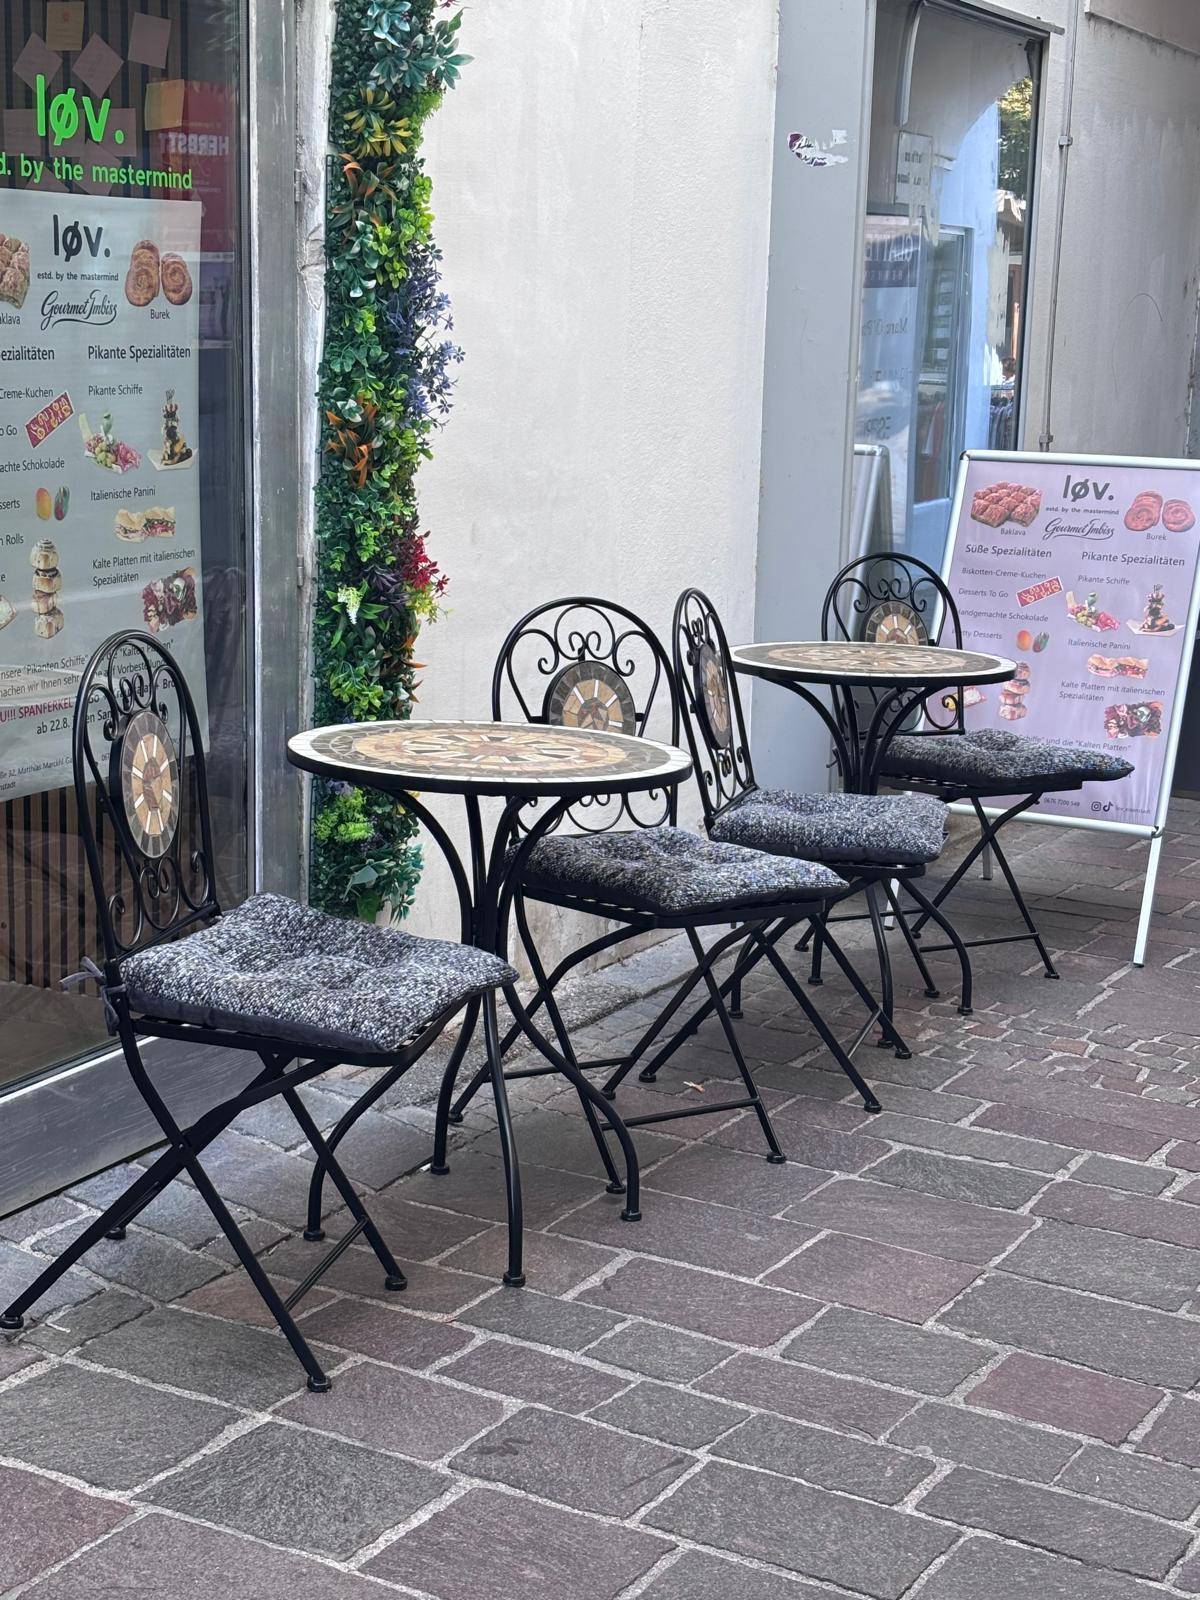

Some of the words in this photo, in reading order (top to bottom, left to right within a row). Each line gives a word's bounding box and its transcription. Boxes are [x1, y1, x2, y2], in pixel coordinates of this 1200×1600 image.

[36, 74, 125, 146] løv.
[20, 153, 44, 184] by
[54, 157, 84, 181] the
[92, 163, 193, 190] mastermind
[53, 214, 111, 262] løv.
[37, 271, 54, 280] estd.
[55, 271, 64, 282] by
[66, 271, 78, 280] the
[80, 272, 119, 281] mastermind
[40, 290, 90, 331] Gourmet
[150, 309, 170, 320] Burek
[88, 345, 126, 360] Pikante
[129, 345, 191, 363] Spezialitäten
[88, 385, 116, 397] Pikante
[118, 383, 143, 395] Schiffe
[6, 424, 17, 436] Go
[22, 457, 65, 471] Schokolade
[90, 487, 132, 501] Italienische
[133, 486, 156, 498] Panini
[1062, 474, 1115, 503] løv.
[1061, 506, 1069, 514] by
[1083, 507, 1119, 515] mastermind
[1000, 527, 1026, 537] Baklava
[1146, 532, 1167, 541] Burek
[1042, 517, 1089, 540] Gourmet
[6, 532, 24, 546] Rolls
[92, 558, 112, 570] Kalte
[113, 554, 140, 568] Platten
[140, 553, 152, 564] mit
[153, 547, 196, 562] italienischen
[991, 545, 1052, 559] Spezialitäten
[1081, 551, 1119, 563] Pikante
[1121, 553, 1186, 567] Spezialitäten
[92, 571, 139, 588] Spezialitäten
[961, 567, 1047, 580] Biskotten-Creme-Kuchen
[1077, 574, 1105, 585] Pikante
[1106, 576, 1131, 586] Schiffe
[958, 587, 987, 598] Desserts
[989, 589, 996, 598] To
[998, 590, 1009, 599] Go
[1008, 611, 1049, 623] Schokolade
[973, 630, 1003, 640] Desserts
[1067, 638, 1107, 649] Italienische
[1108, 641, 1131, 651] Panini
[27, 681, 39, 692] wir
[41, 677, 62, 689] Ihnen
[1061, 680, 1079, 690] Kalte
[1080, 682, 1106, 692] Platten
[1107, 684, 1119, 693] mit
[1120, 686, 1166, 697] italienischen
[1058, 690, 1104, 703] Spezialitäten
[18, 697, 74, 719] SPANFERKEL
[36, 720, 48, 735] ab
